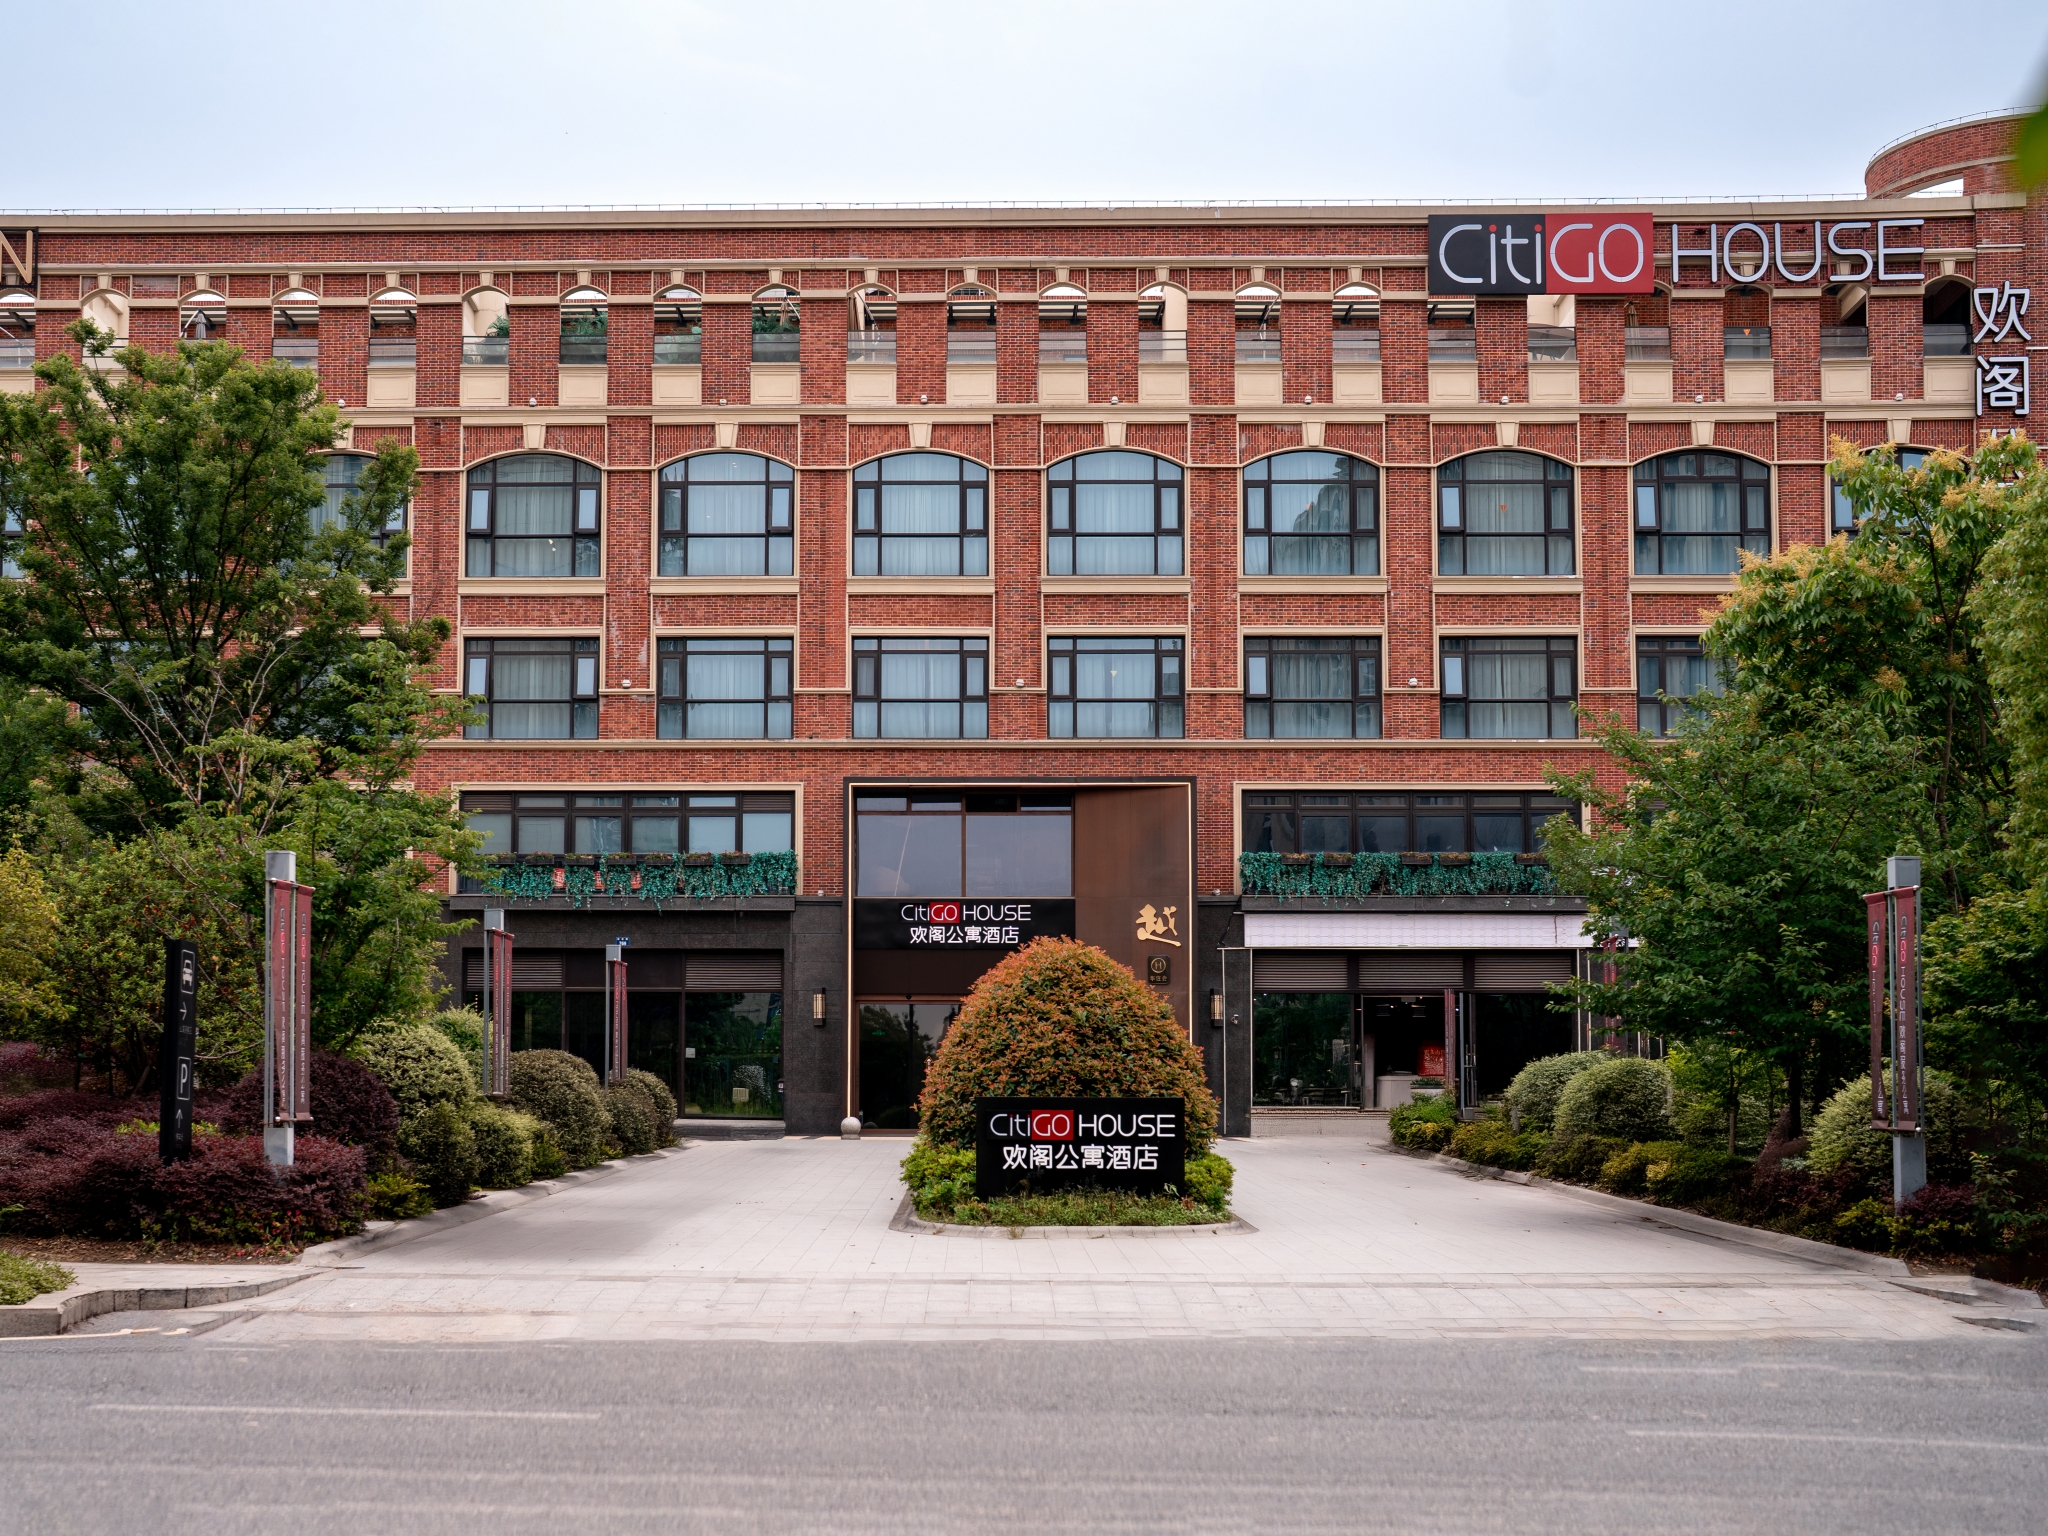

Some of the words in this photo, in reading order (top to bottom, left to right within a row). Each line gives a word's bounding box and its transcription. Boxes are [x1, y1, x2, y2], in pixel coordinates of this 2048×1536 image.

[1439, 222, 1645, 285] CitiGO
[1672, 218, 1925, 284] HOUSE
[1973, 280, 2032, 488] 欢阁
[901, 904, 958, 922] CitiGO
[963, 904, 1032, 922] HOUSE
[909, 925, 1020, 944] 欢阁公寓酒店
[180, 1063, 188, 1094] P
[989, 1113, 1071, 1138] CitiGO
[1078, 1113, 1176, 1138] HOUSE
[1002, 1143, 1160, 1170] 欢阁公寓酒店
